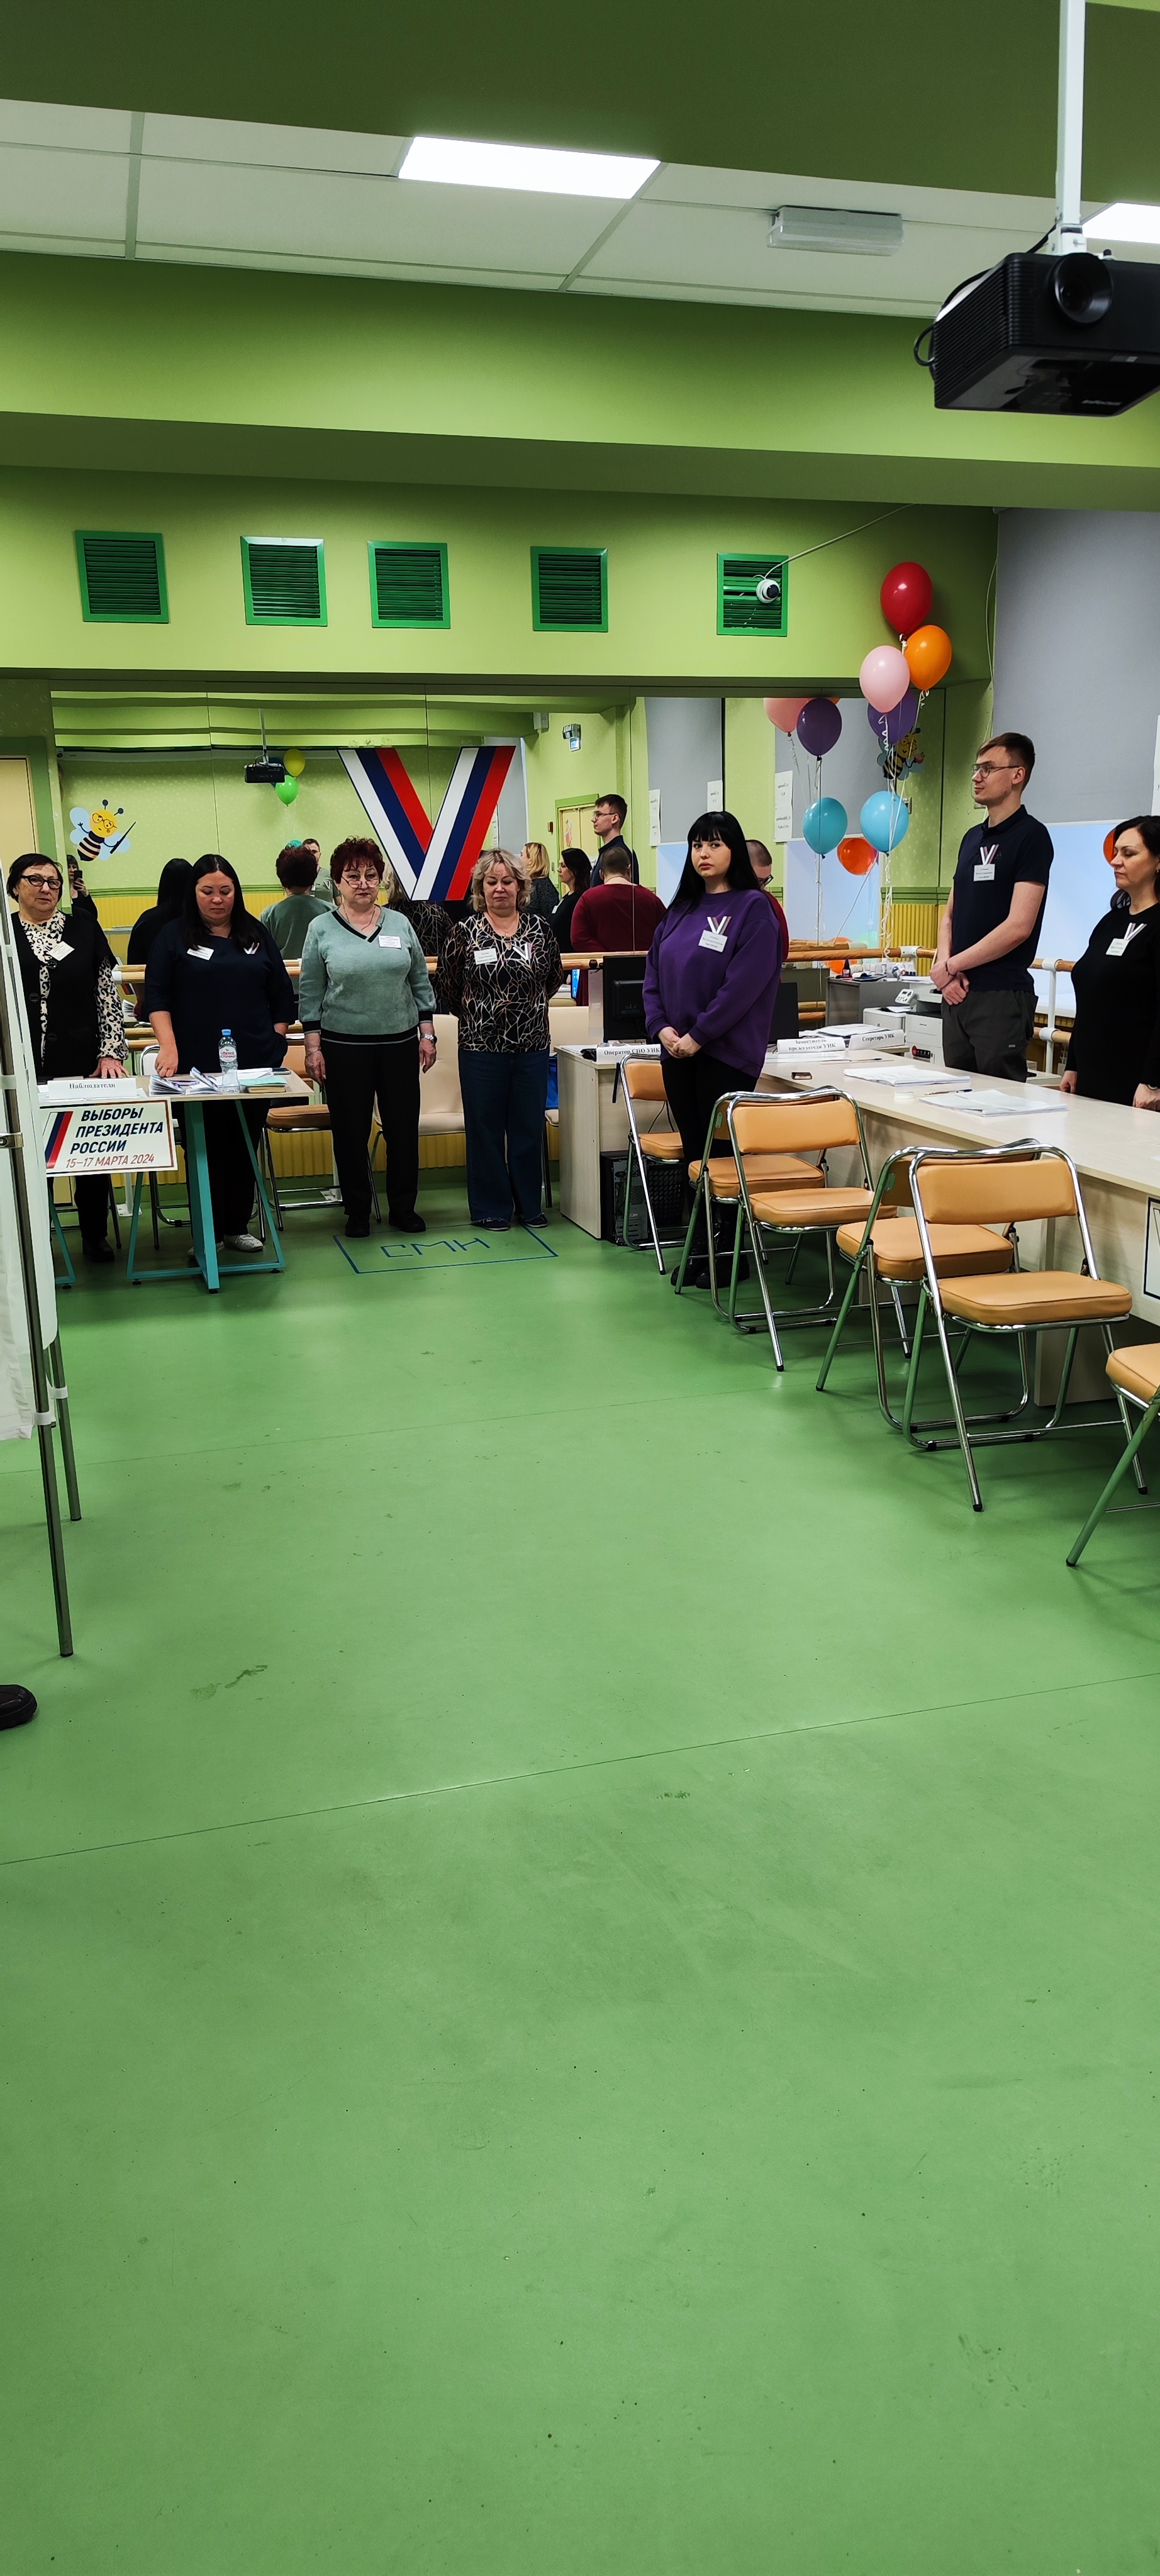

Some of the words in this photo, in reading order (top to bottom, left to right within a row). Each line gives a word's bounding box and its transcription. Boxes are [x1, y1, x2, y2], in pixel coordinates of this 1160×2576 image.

[81, 1108, 144, 1122] ВЫБОРЫ
[75, 1121, 164, 1138] ПРЕЗИДЕНТА
[70, 1140, 127, 1155] РОССИИ
[94, 1155, 128, 1167] МАРТА
[130, 1153, 155, 1164] 2024
